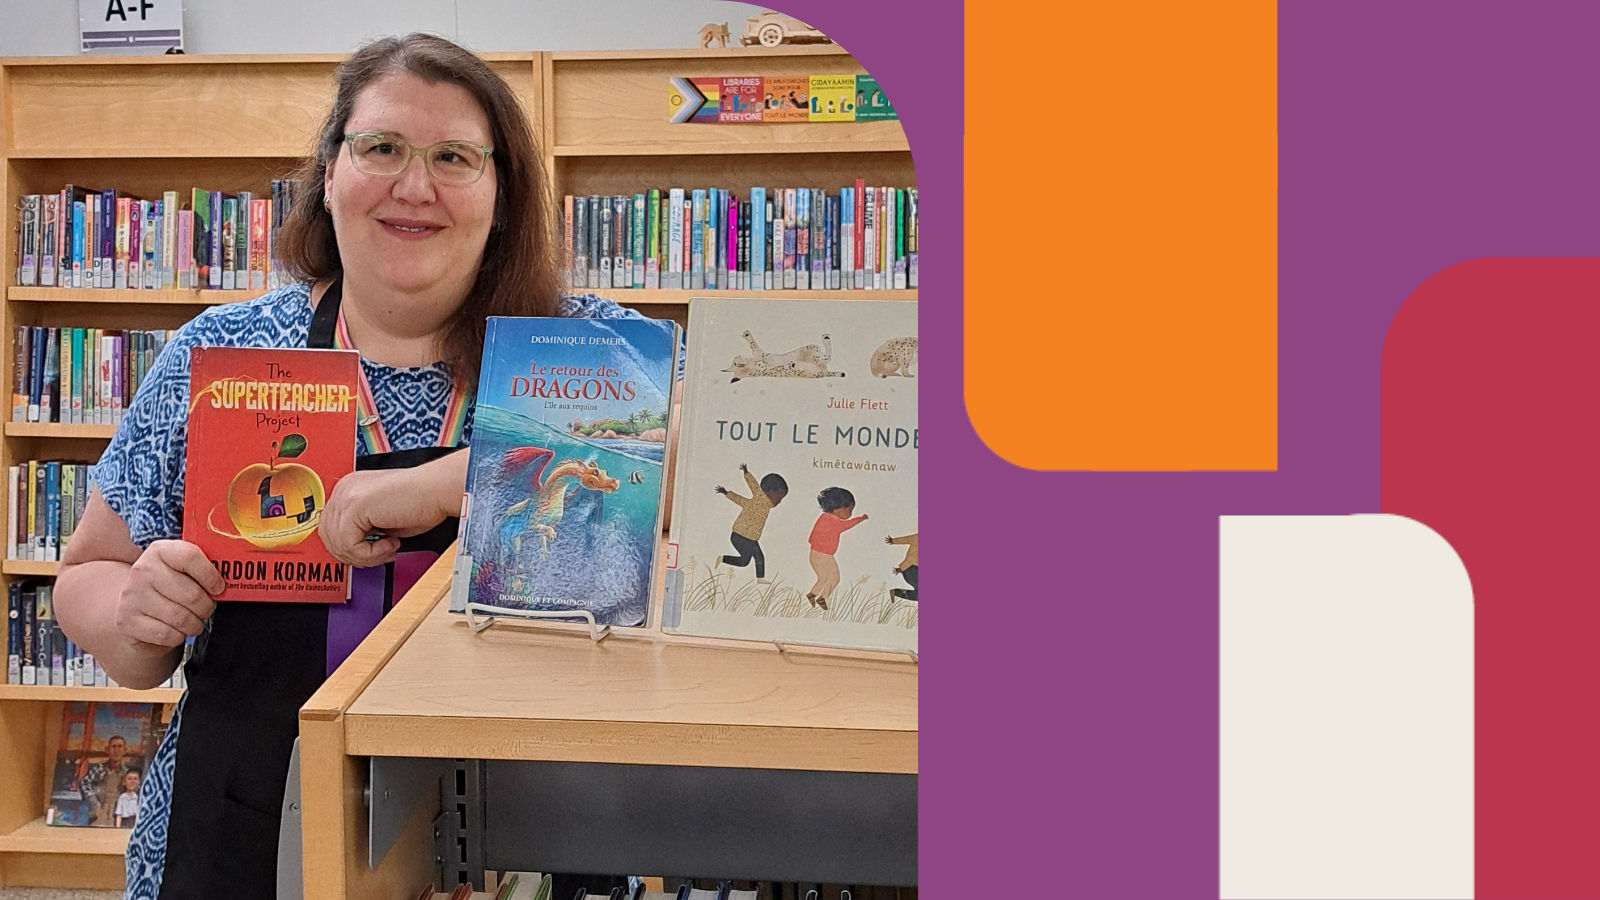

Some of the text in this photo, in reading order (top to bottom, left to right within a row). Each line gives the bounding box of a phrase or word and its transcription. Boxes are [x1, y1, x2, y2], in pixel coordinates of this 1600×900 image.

[723, 78, 760, 86] LIBRARIES
[724, 86, 757, 94] ARE FOR
[720, 112, 762, 121] EVERYONE
[672, 205, 681, 244] COURAGE
[693, 220, 703, 255] THE BRAVE
[531, 335, 626, 346] DOMINIQUE DEMERS
[265, 363, 292, 379] The
[530, 362, 619, 377] Le retour des
[210, 380, 350, 413] SUPERTEACHER
[510, 376, 636, 402] DRAGONS
[572, 404, 598, 412] requins
[826, 396, 889, 411] Julie Flett
[256, 412, 301, 433] Project
[715, 420, 778, 443] TOUT
[792, 423, 820, 444] LE
[812, 457, 897, 472] kimêtawânaw
[210, 560, 345, 582] RDON KORMAN
[498, 593, 595, 607] DOMINIQUE ET COMPAGNIE
